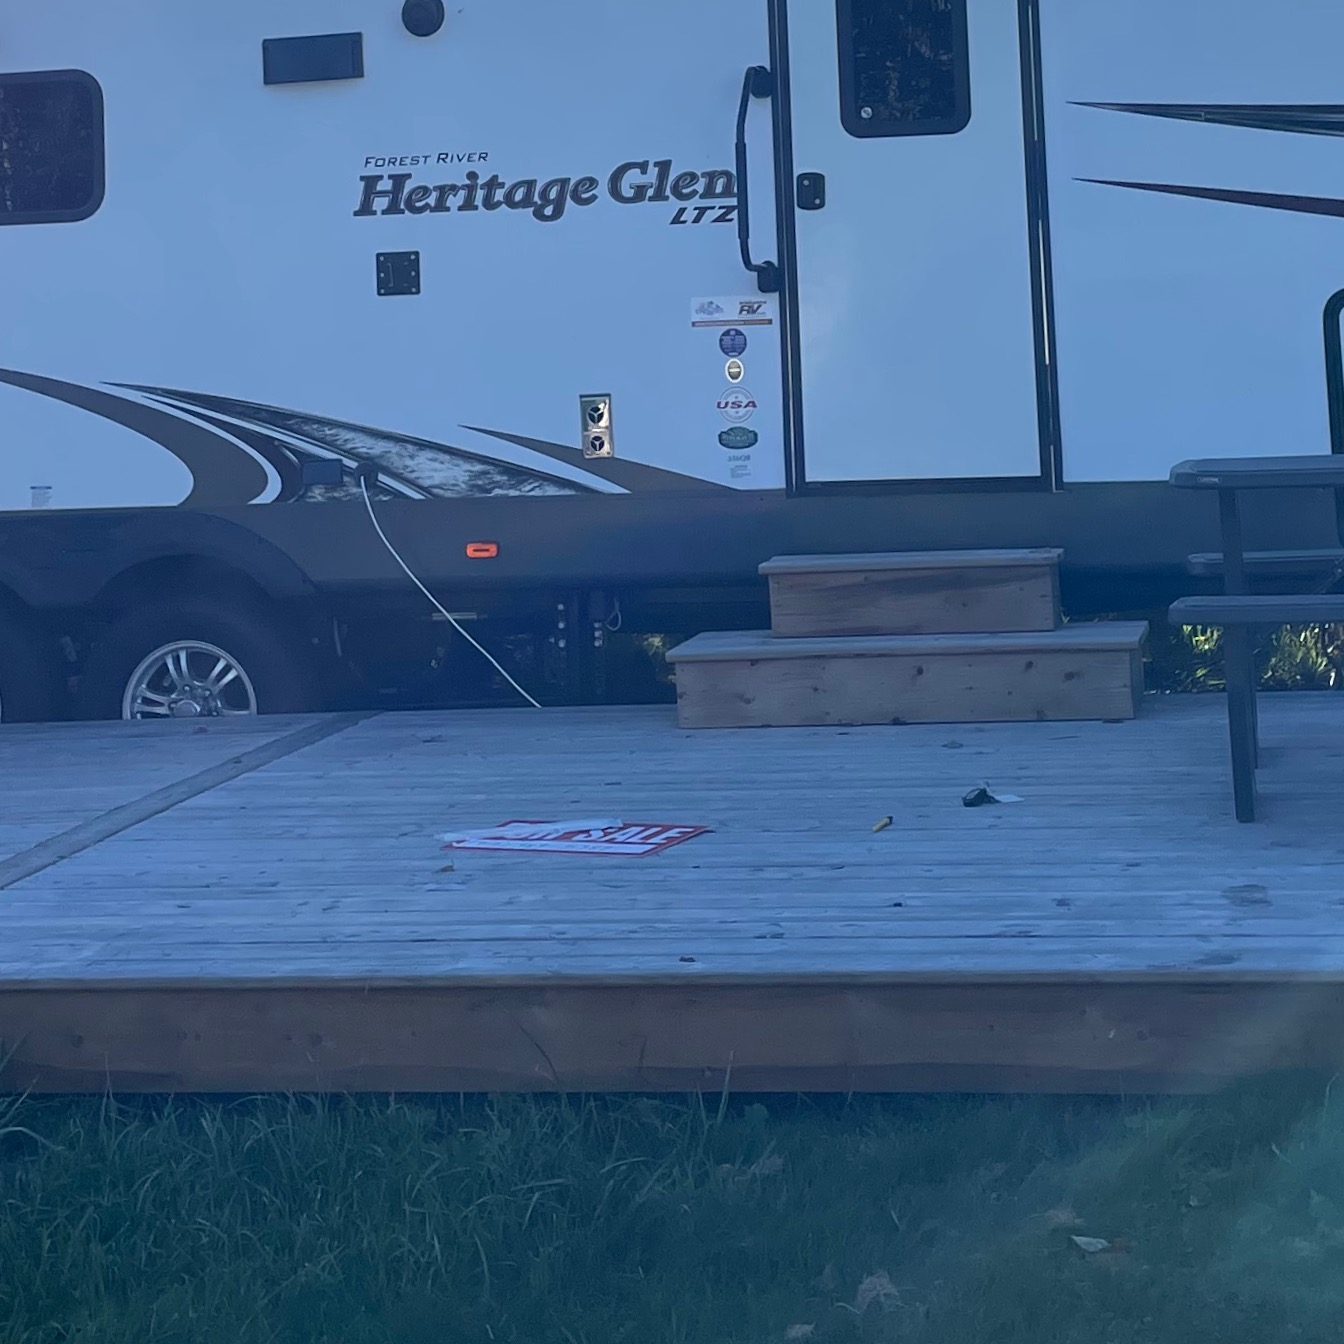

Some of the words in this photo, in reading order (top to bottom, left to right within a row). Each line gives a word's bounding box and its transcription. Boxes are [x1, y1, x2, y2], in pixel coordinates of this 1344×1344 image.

[364, 156, 431, 168] FOREST
[437, 152, 489, 164] RIVER
[353, 171, 599, 222] Heritage
[608, 159, 738, 204] Glen
[669, 205, 738, 225] LTZ
[738, 304, 762, 315] RV
[717, 400, 757, 409] USA
[572, 826, 695, 844] SALE
